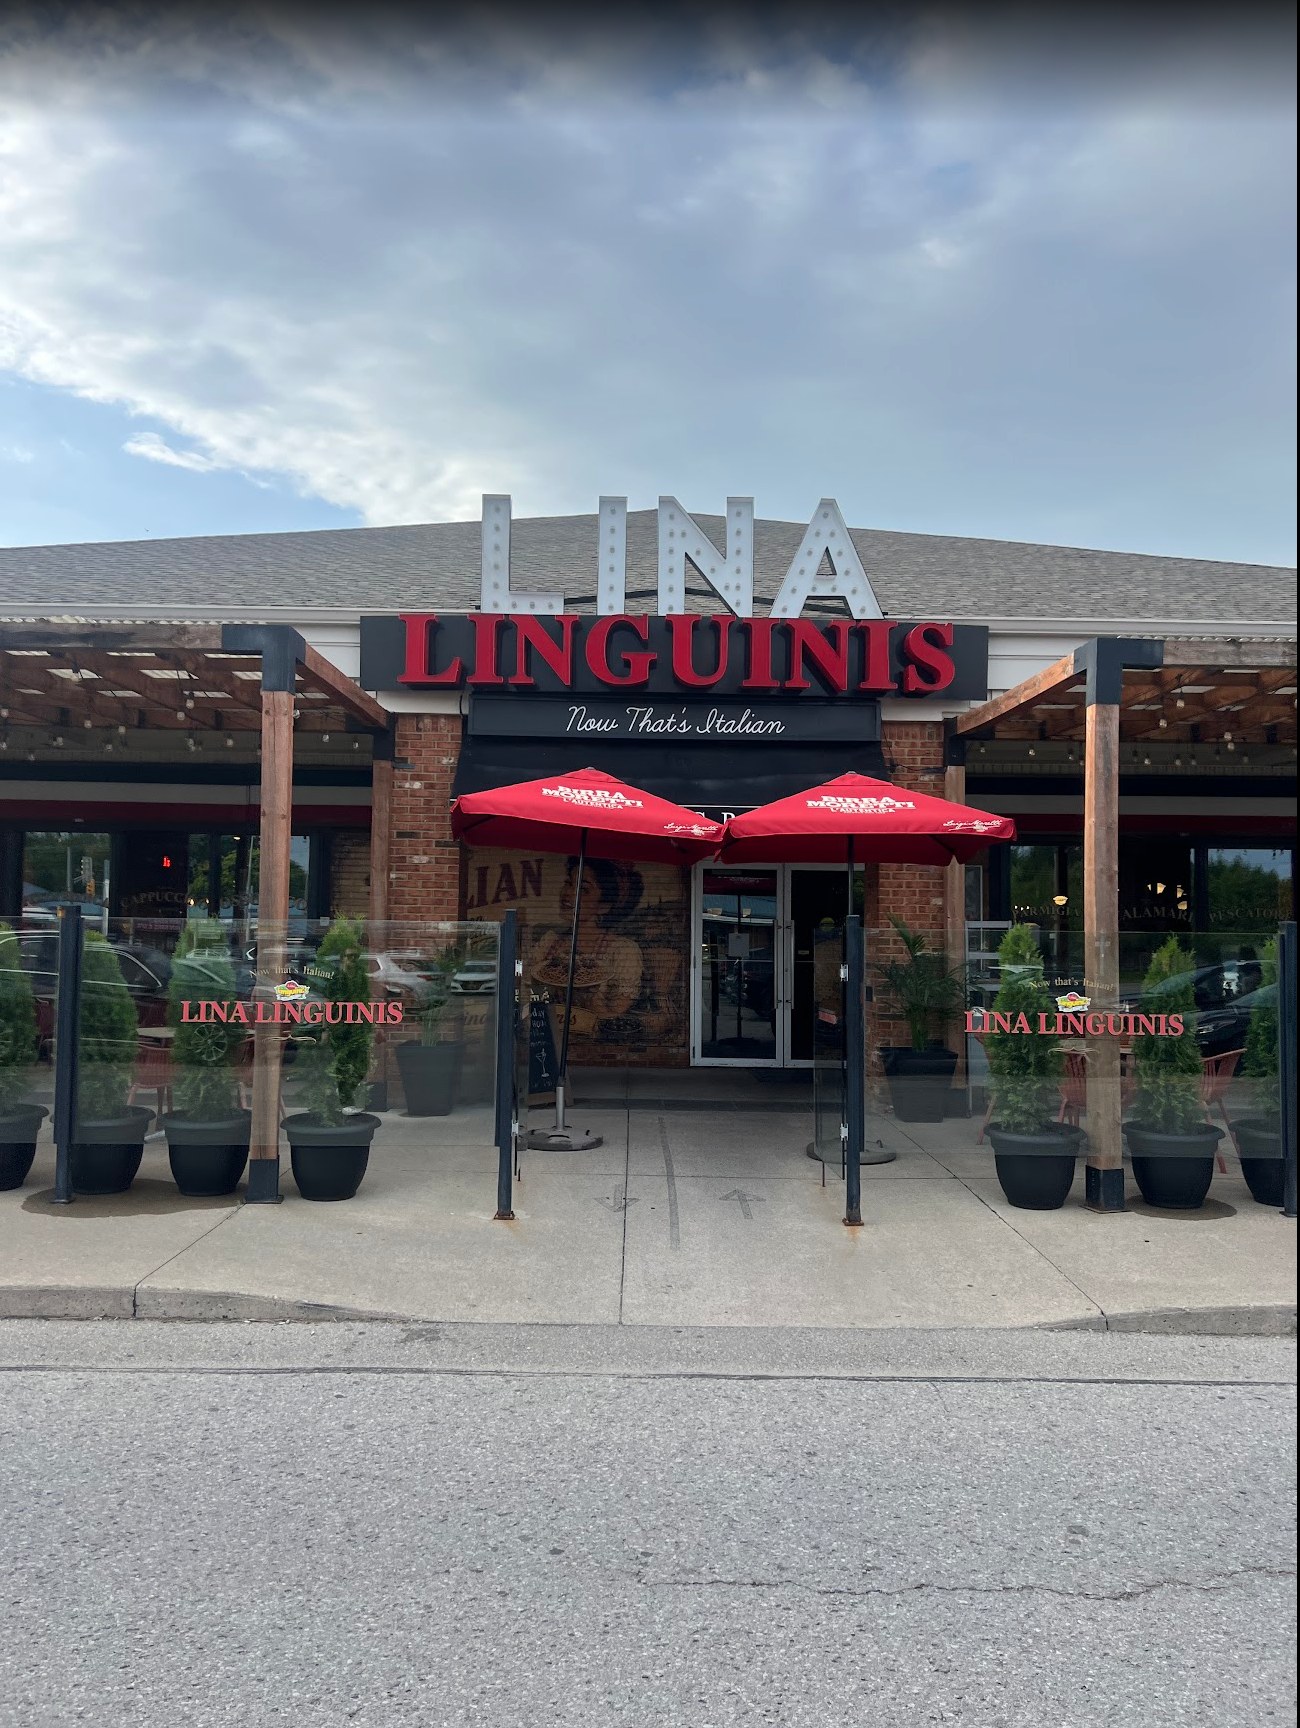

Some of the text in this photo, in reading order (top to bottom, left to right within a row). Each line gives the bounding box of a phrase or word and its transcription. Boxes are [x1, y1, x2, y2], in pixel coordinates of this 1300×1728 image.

[480, 494, 887, 618] LINA
[397, 612, 955, 694] LINGUINIS
[566, 706, 785, 734] Now That's Italian
[542, 788, 644, 808] MORETTI
[806, 800, 916, 810] MORETTI
[467, 858, 545, 908] IAN
[1009, 904, 1081, 918] PARMIGIA
[1120, 906, 1194, 922] ALAMARI
[302, 966, 335, 980] Italian!
[1029, 977, 1115, 991] Now that's Italian!
[180, 1000, 404, 1025] LINA LINGUINIS
[964, 1011, 1185, 1037] LINA LINGUINIS
